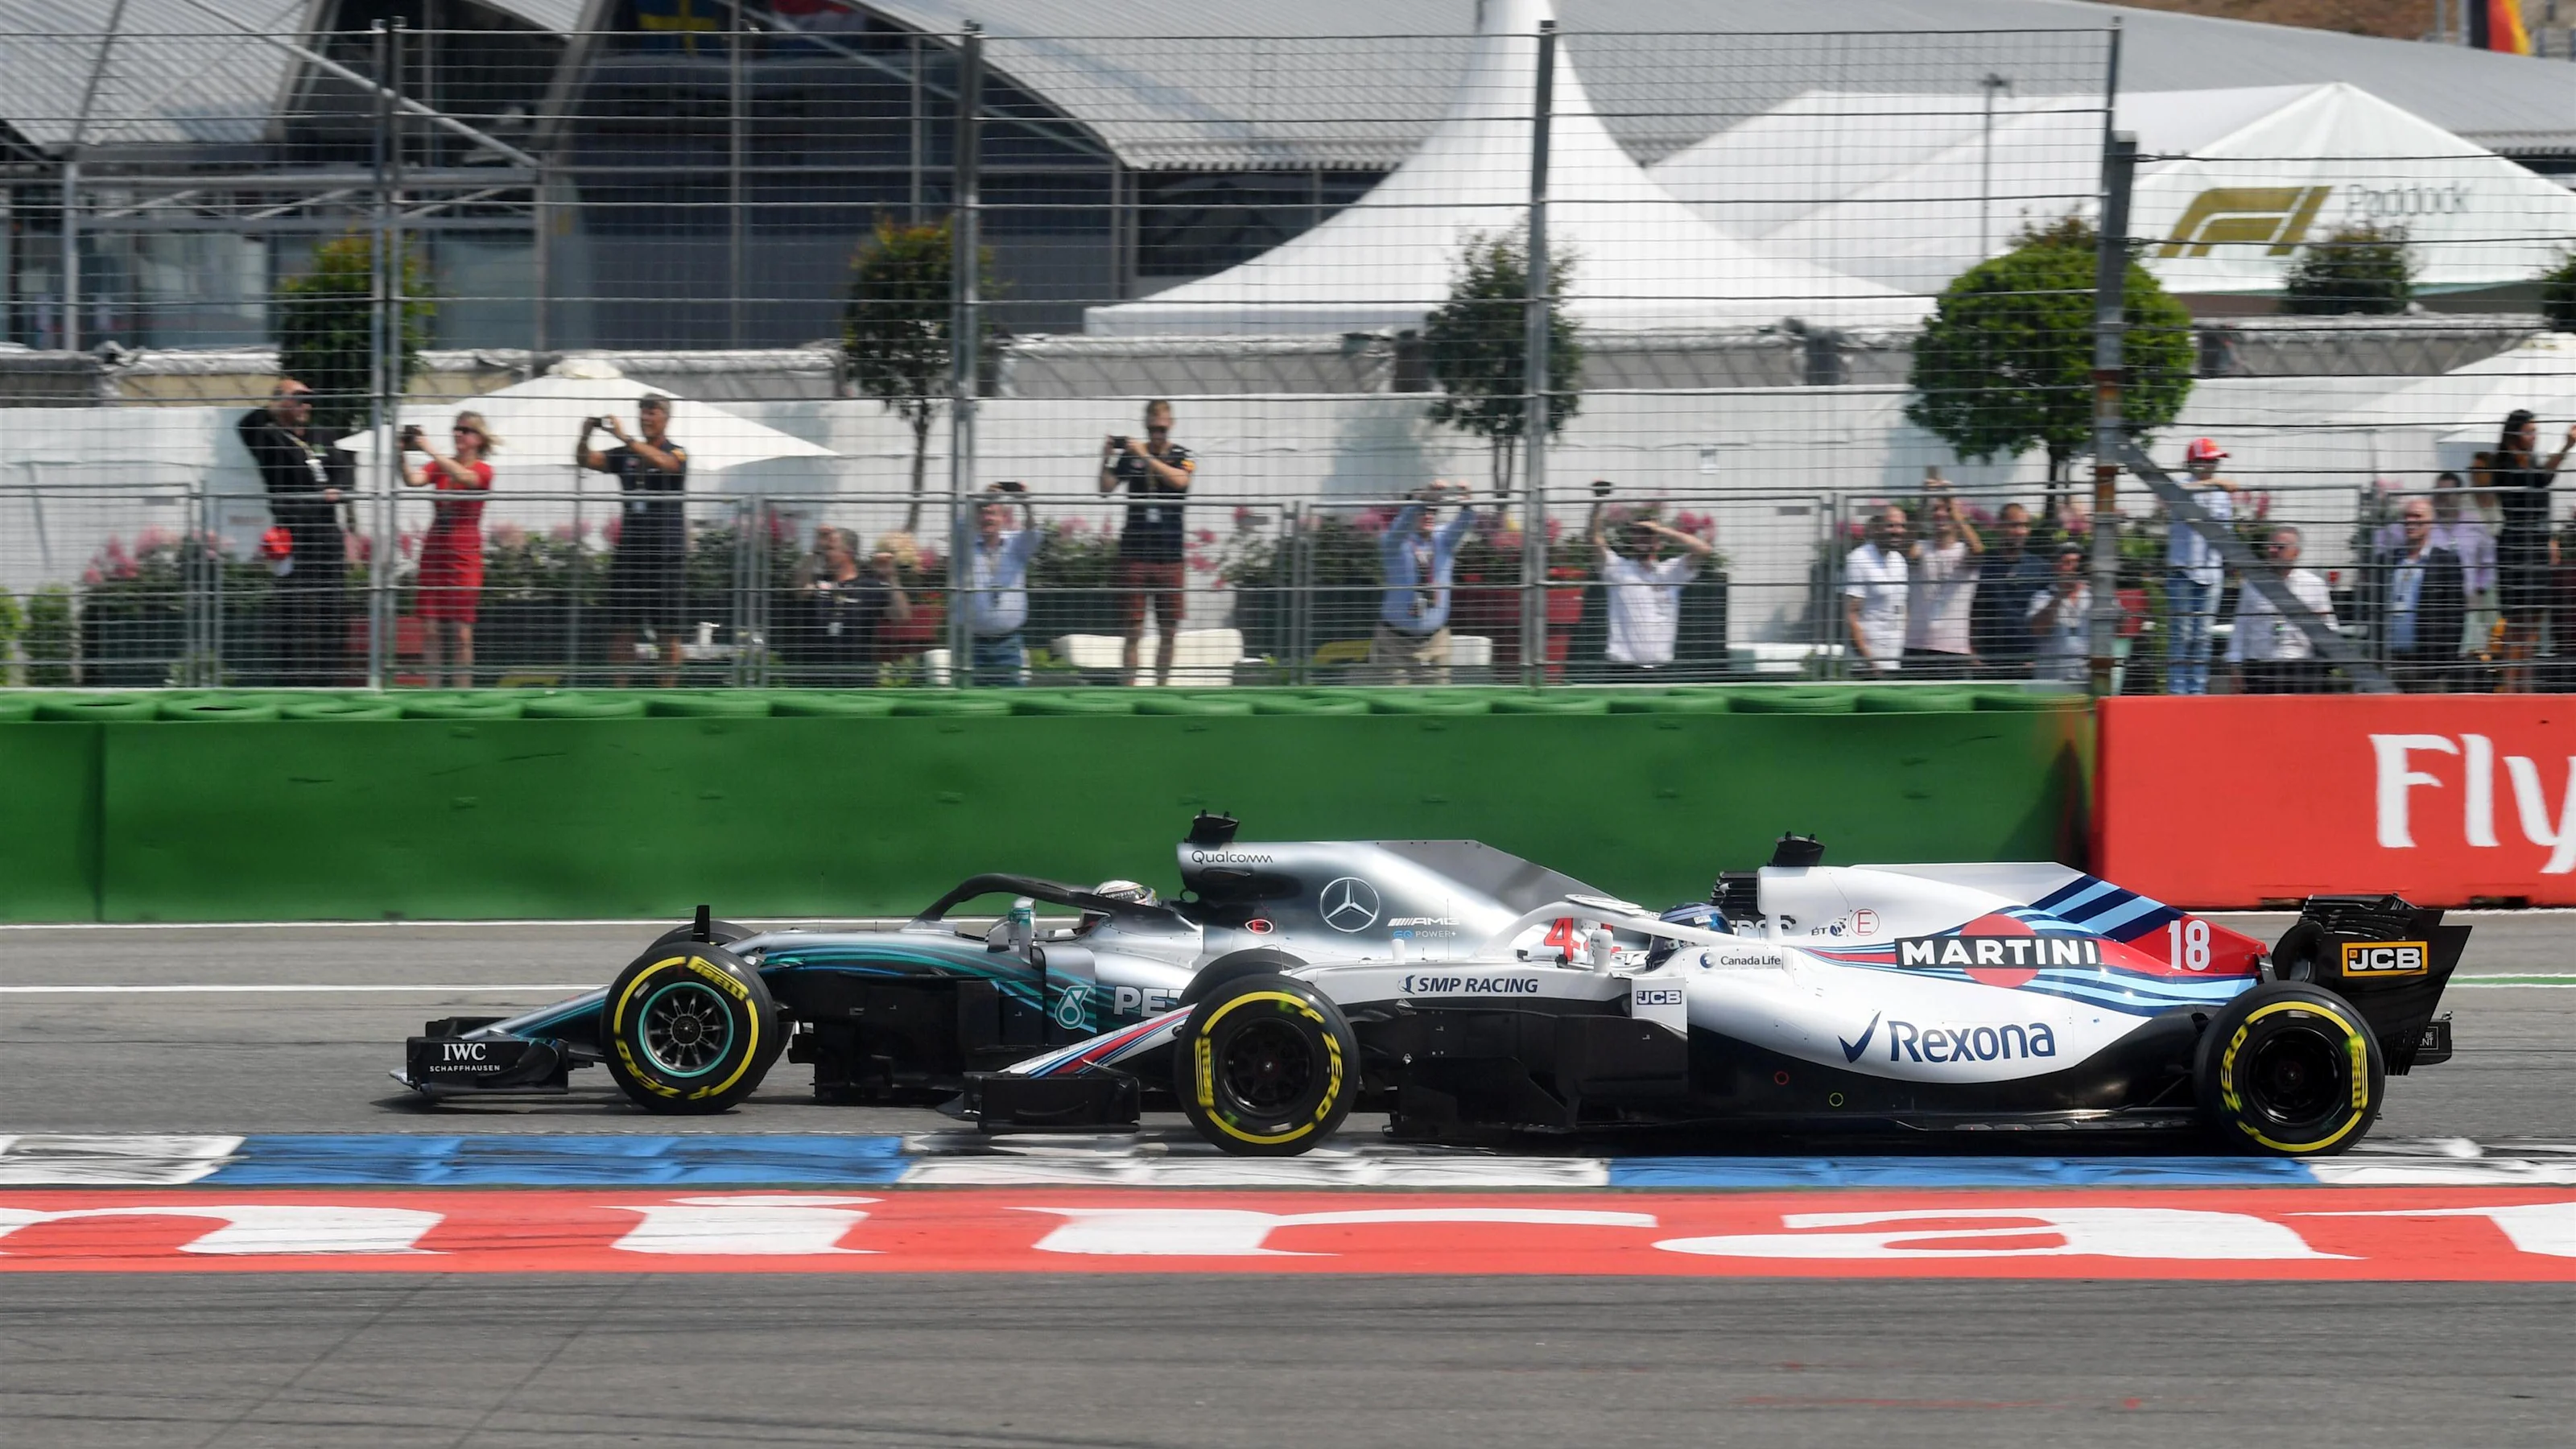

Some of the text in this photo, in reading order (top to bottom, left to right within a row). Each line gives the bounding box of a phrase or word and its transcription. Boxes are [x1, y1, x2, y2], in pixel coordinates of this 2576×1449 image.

[1191, 849, 1274, 864] Qualcomm
[1411, 917, 1459, 927] AMG
[1901, 939, 2097, 967] MARTINI
[2166, 920, 2211, 971] 18
[1720, 955, 1781, 965] Canada Life
[2349, 948, 2421, 970] JCB
[1418, 978, 1538, 993] SMP RACING
[1638, 991, 1682, 1004] JCB
[1887, 1021, 2056, 1063] Rexona
[2419, 1038, 2434, 1046] NT
[443, 1043, 486, 1061] IWC
[429, 1064, 501, 1072] SCHAFFHAUSEN
